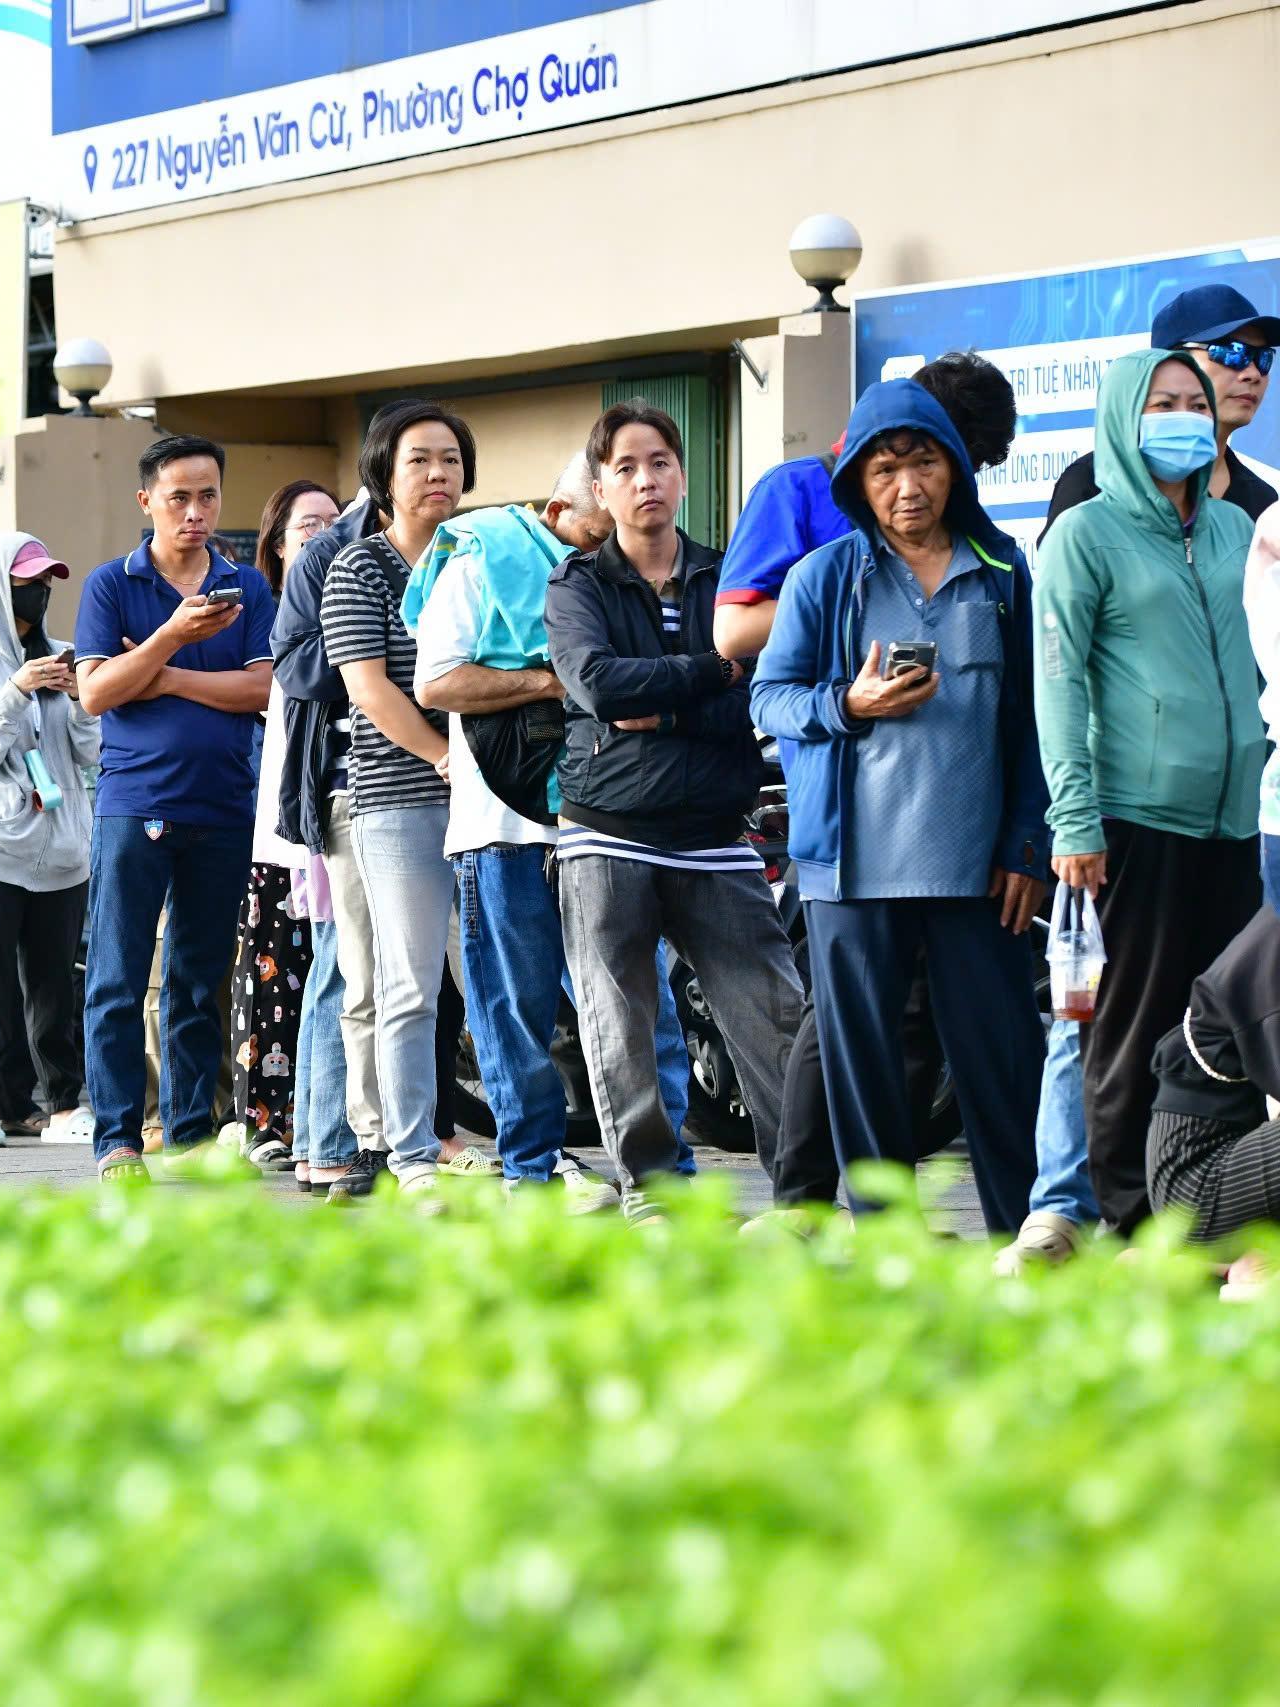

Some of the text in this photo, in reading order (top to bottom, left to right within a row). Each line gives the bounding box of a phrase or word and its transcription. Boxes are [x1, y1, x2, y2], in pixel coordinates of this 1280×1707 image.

[112, 43, 618, 190] 227 Nguyễn Văn Cừ, Phường Chợ Quán
[1063, 355, 1102, 392] NHÂN
